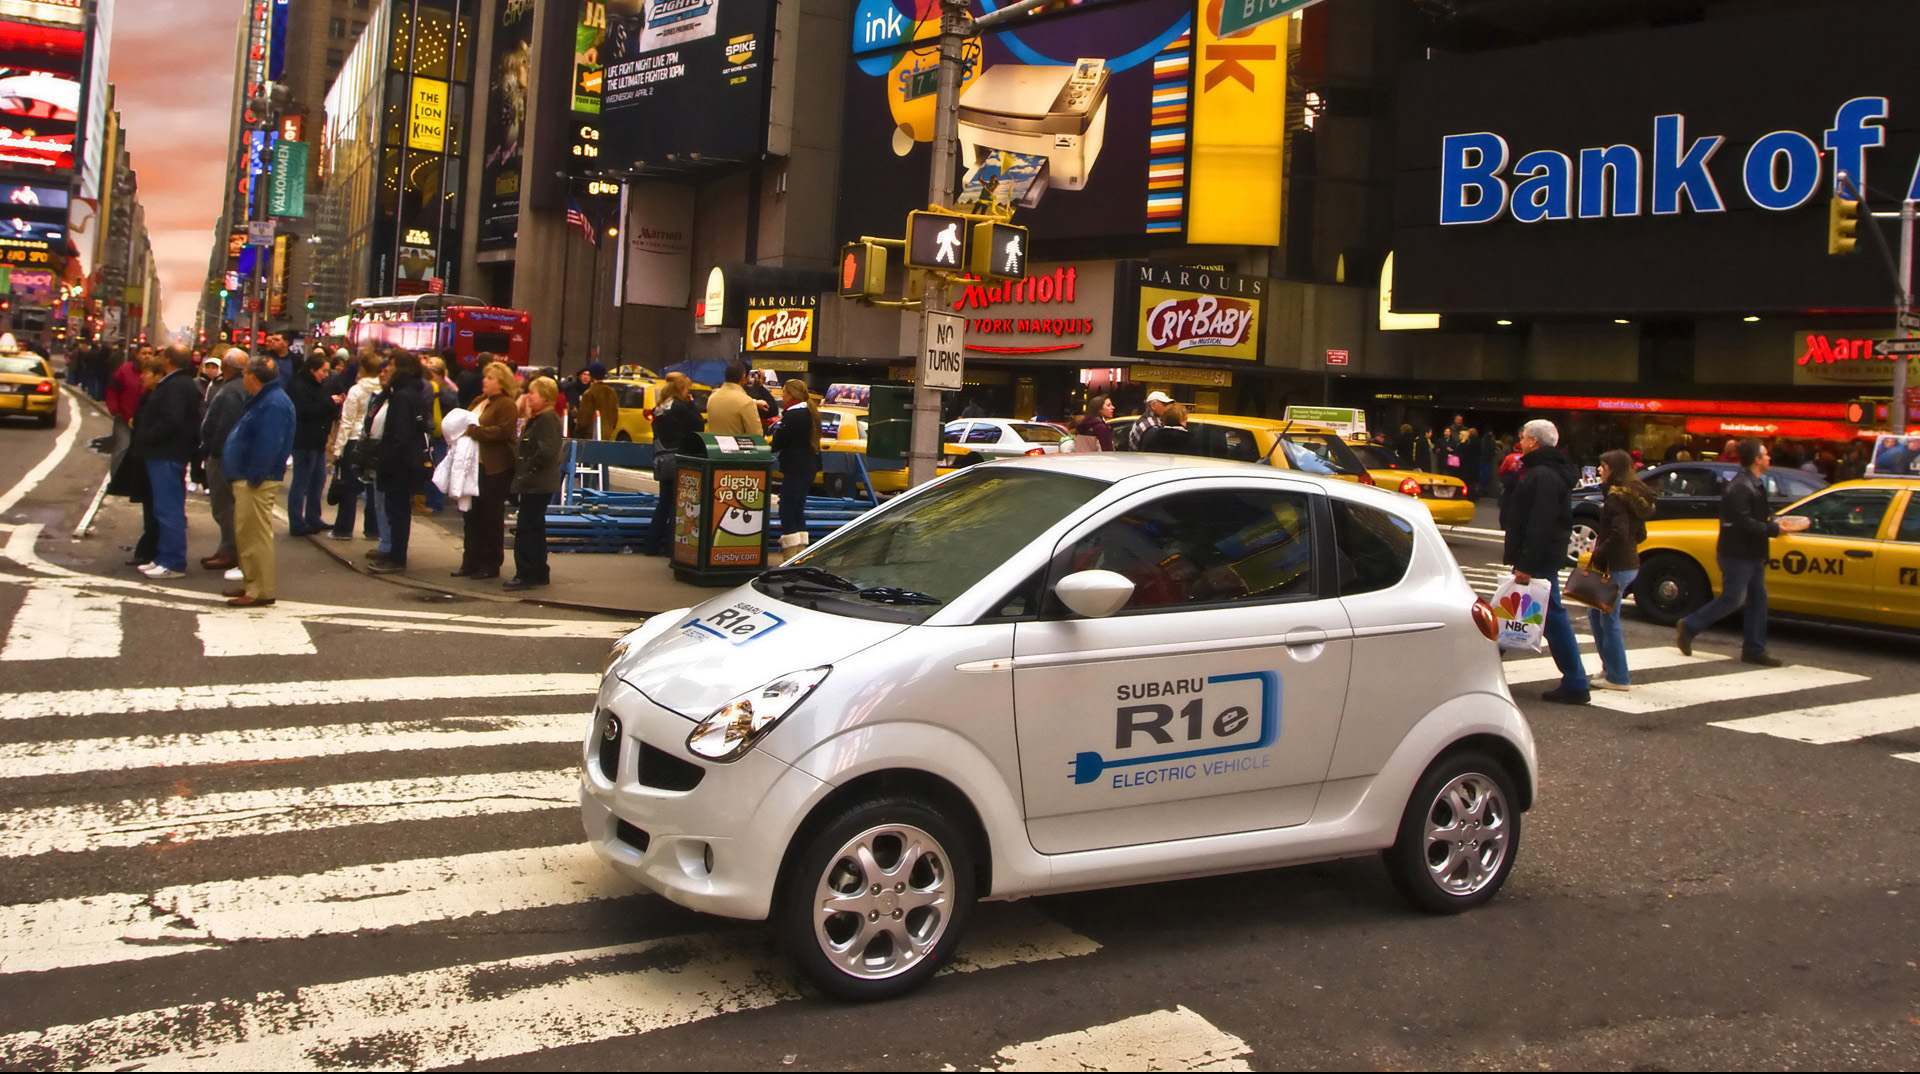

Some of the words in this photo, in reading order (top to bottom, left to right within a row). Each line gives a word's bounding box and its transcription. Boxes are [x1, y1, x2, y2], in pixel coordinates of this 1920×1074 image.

[866, 7, 902, 43] ink
[725, 40, 757, 56] SPIKE
[607, 65, 618, 78] UFC
[619, 61, 635, 75] FIGHT
[635, 57, 652, 72] NIGHT
[652, 54, 666, 69] LIVE
[666, 51, 679, 66] 7PM
[607, 78, 618, 91] THE
[618, 73, 644, 89] ULTIMATE
[645, 67, 669, 83] FIGHTER
[669, 64, 685, 79] 10PM
[916, 75, 924, 94] 7
[420, 91, 439, 103] THE
[606, 91, 634, 103] WEDNESDAY
[635, 88, 648, 98] APRIL
[649, 87, 654, 96] 2
[415, 103, 442, 119] LION
[413, 122, 441, 139] KING
[580, 126, 600, 140] Ca
[573, 145, 582, 155] a
[1440, 113, 1727, 225] Bank
[1743, 96, 1889, 211] of
[273, 144, 290, 212] VÄLKOMMEN
[588, 180, 619, 195] give
[954, 267, 1077, 311] Marriott
[1141, 266, 1261, 294] MARQUIS
[748, 295, 816, 307] MARQUIS
[937, 324, 954, 345] NO
[974, 318, 1013, 333] YORK
[1017, 318, 1093, 336] MARQUIS
[929, 349, 960, 373] TURNS
[720, 474, 760, 490] digsby
[719, 490, 733, 503] ya
[736, 488, 759, 503] dig!
[714, 553, 758, 562] digsby.com
[733, 602, 763, 615] SUBARU
[706, 608, 756, 635] R1e
[1505, 620, 1529, 634] NBC
[1117, 677, 1204, 700] SUBARU
[1115, 698, 1249, 749] R1e
[1112, 764, 1197, 789] ELECTRIC
[1202, 754, 1271, 776] VEHICLE
